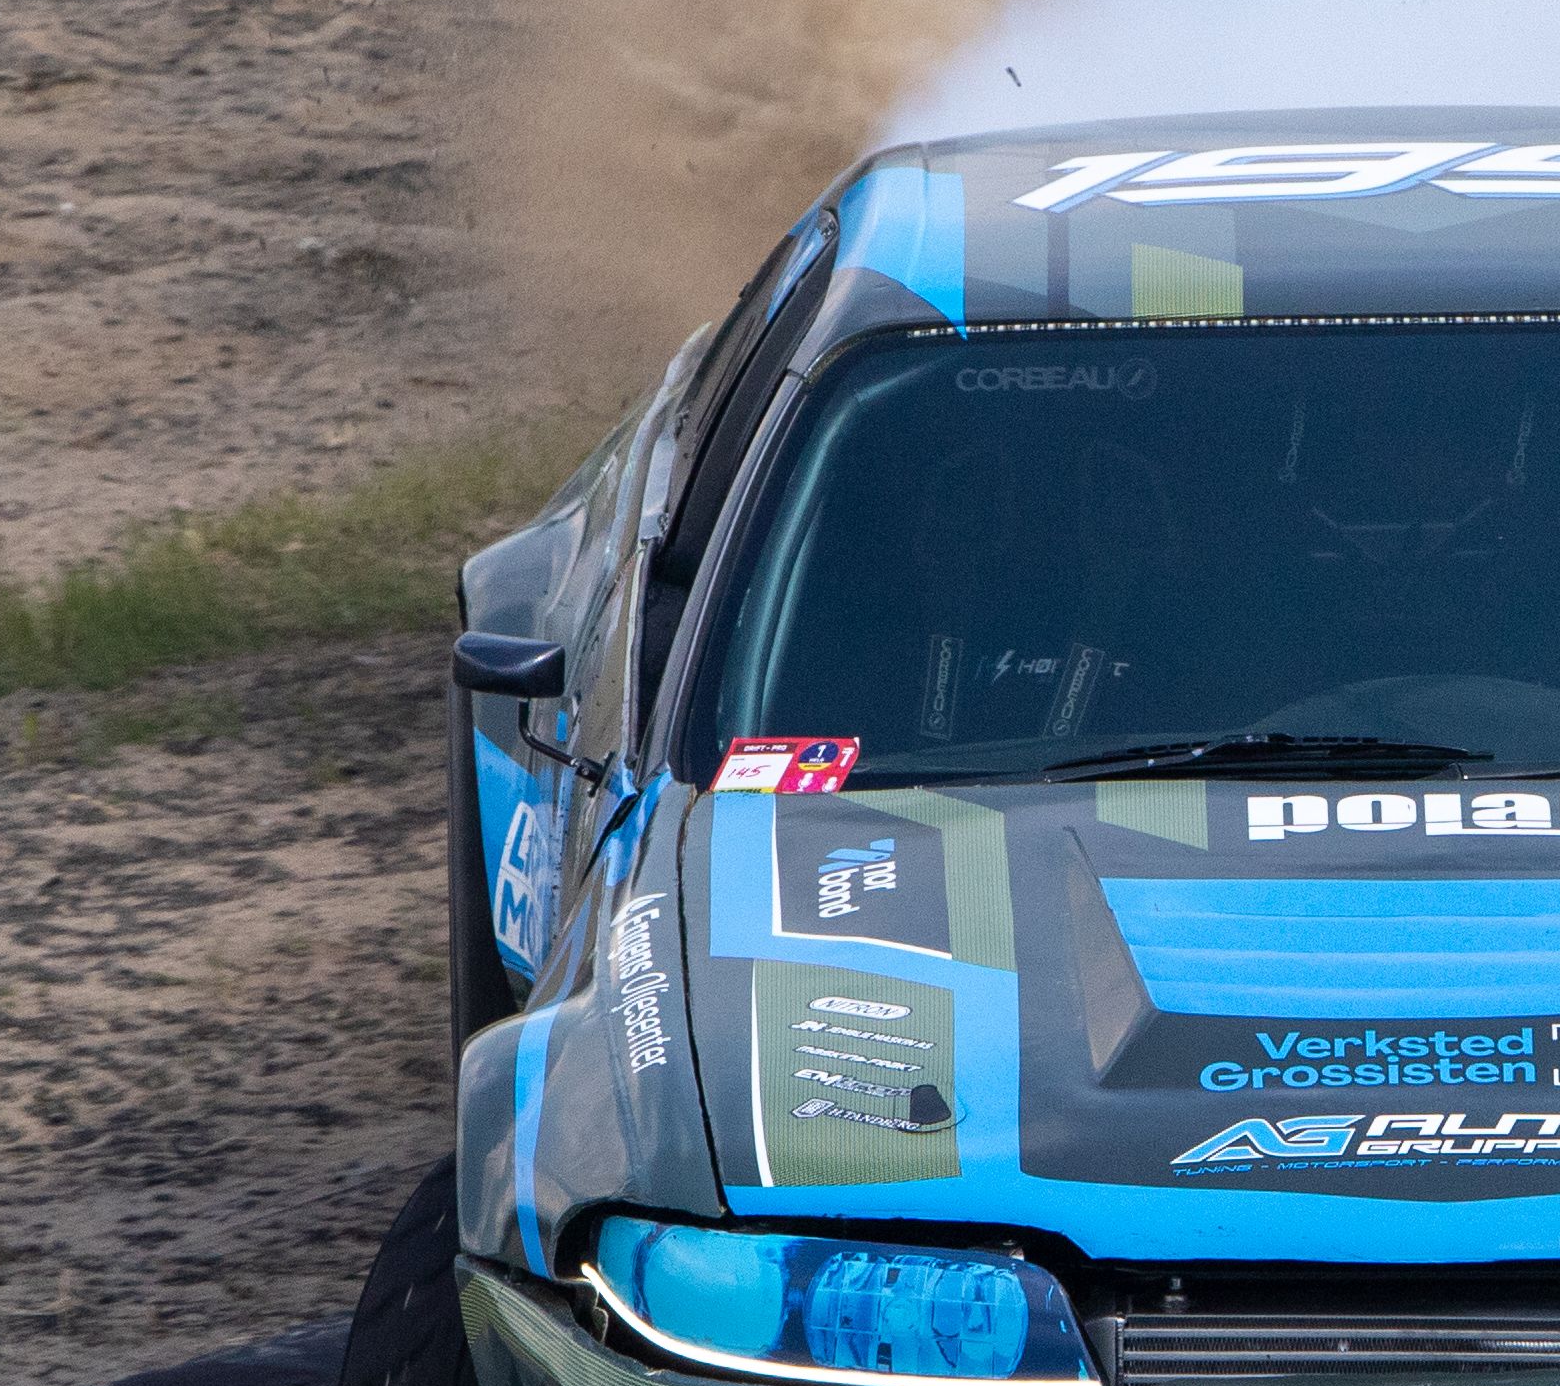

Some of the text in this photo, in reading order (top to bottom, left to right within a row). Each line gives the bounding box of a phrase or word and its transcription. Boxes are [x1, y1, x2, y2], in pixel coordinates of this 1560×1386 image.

[955, 366, 1117, 392] CORBEAU
[863, 860, 897, 892] nor
[607, 907, 672, 1074] Engens Oljesenter
[822, 998, 898, 1017] NITRON
[1256, 1027, 1534, 1059] Verksted
[1200, 1056, 1536, 1092] Grossisten
[1173, 1164, 1254, 1177] TUNING
[1277, 1158, 1433, 1171] MOTORSPORT
